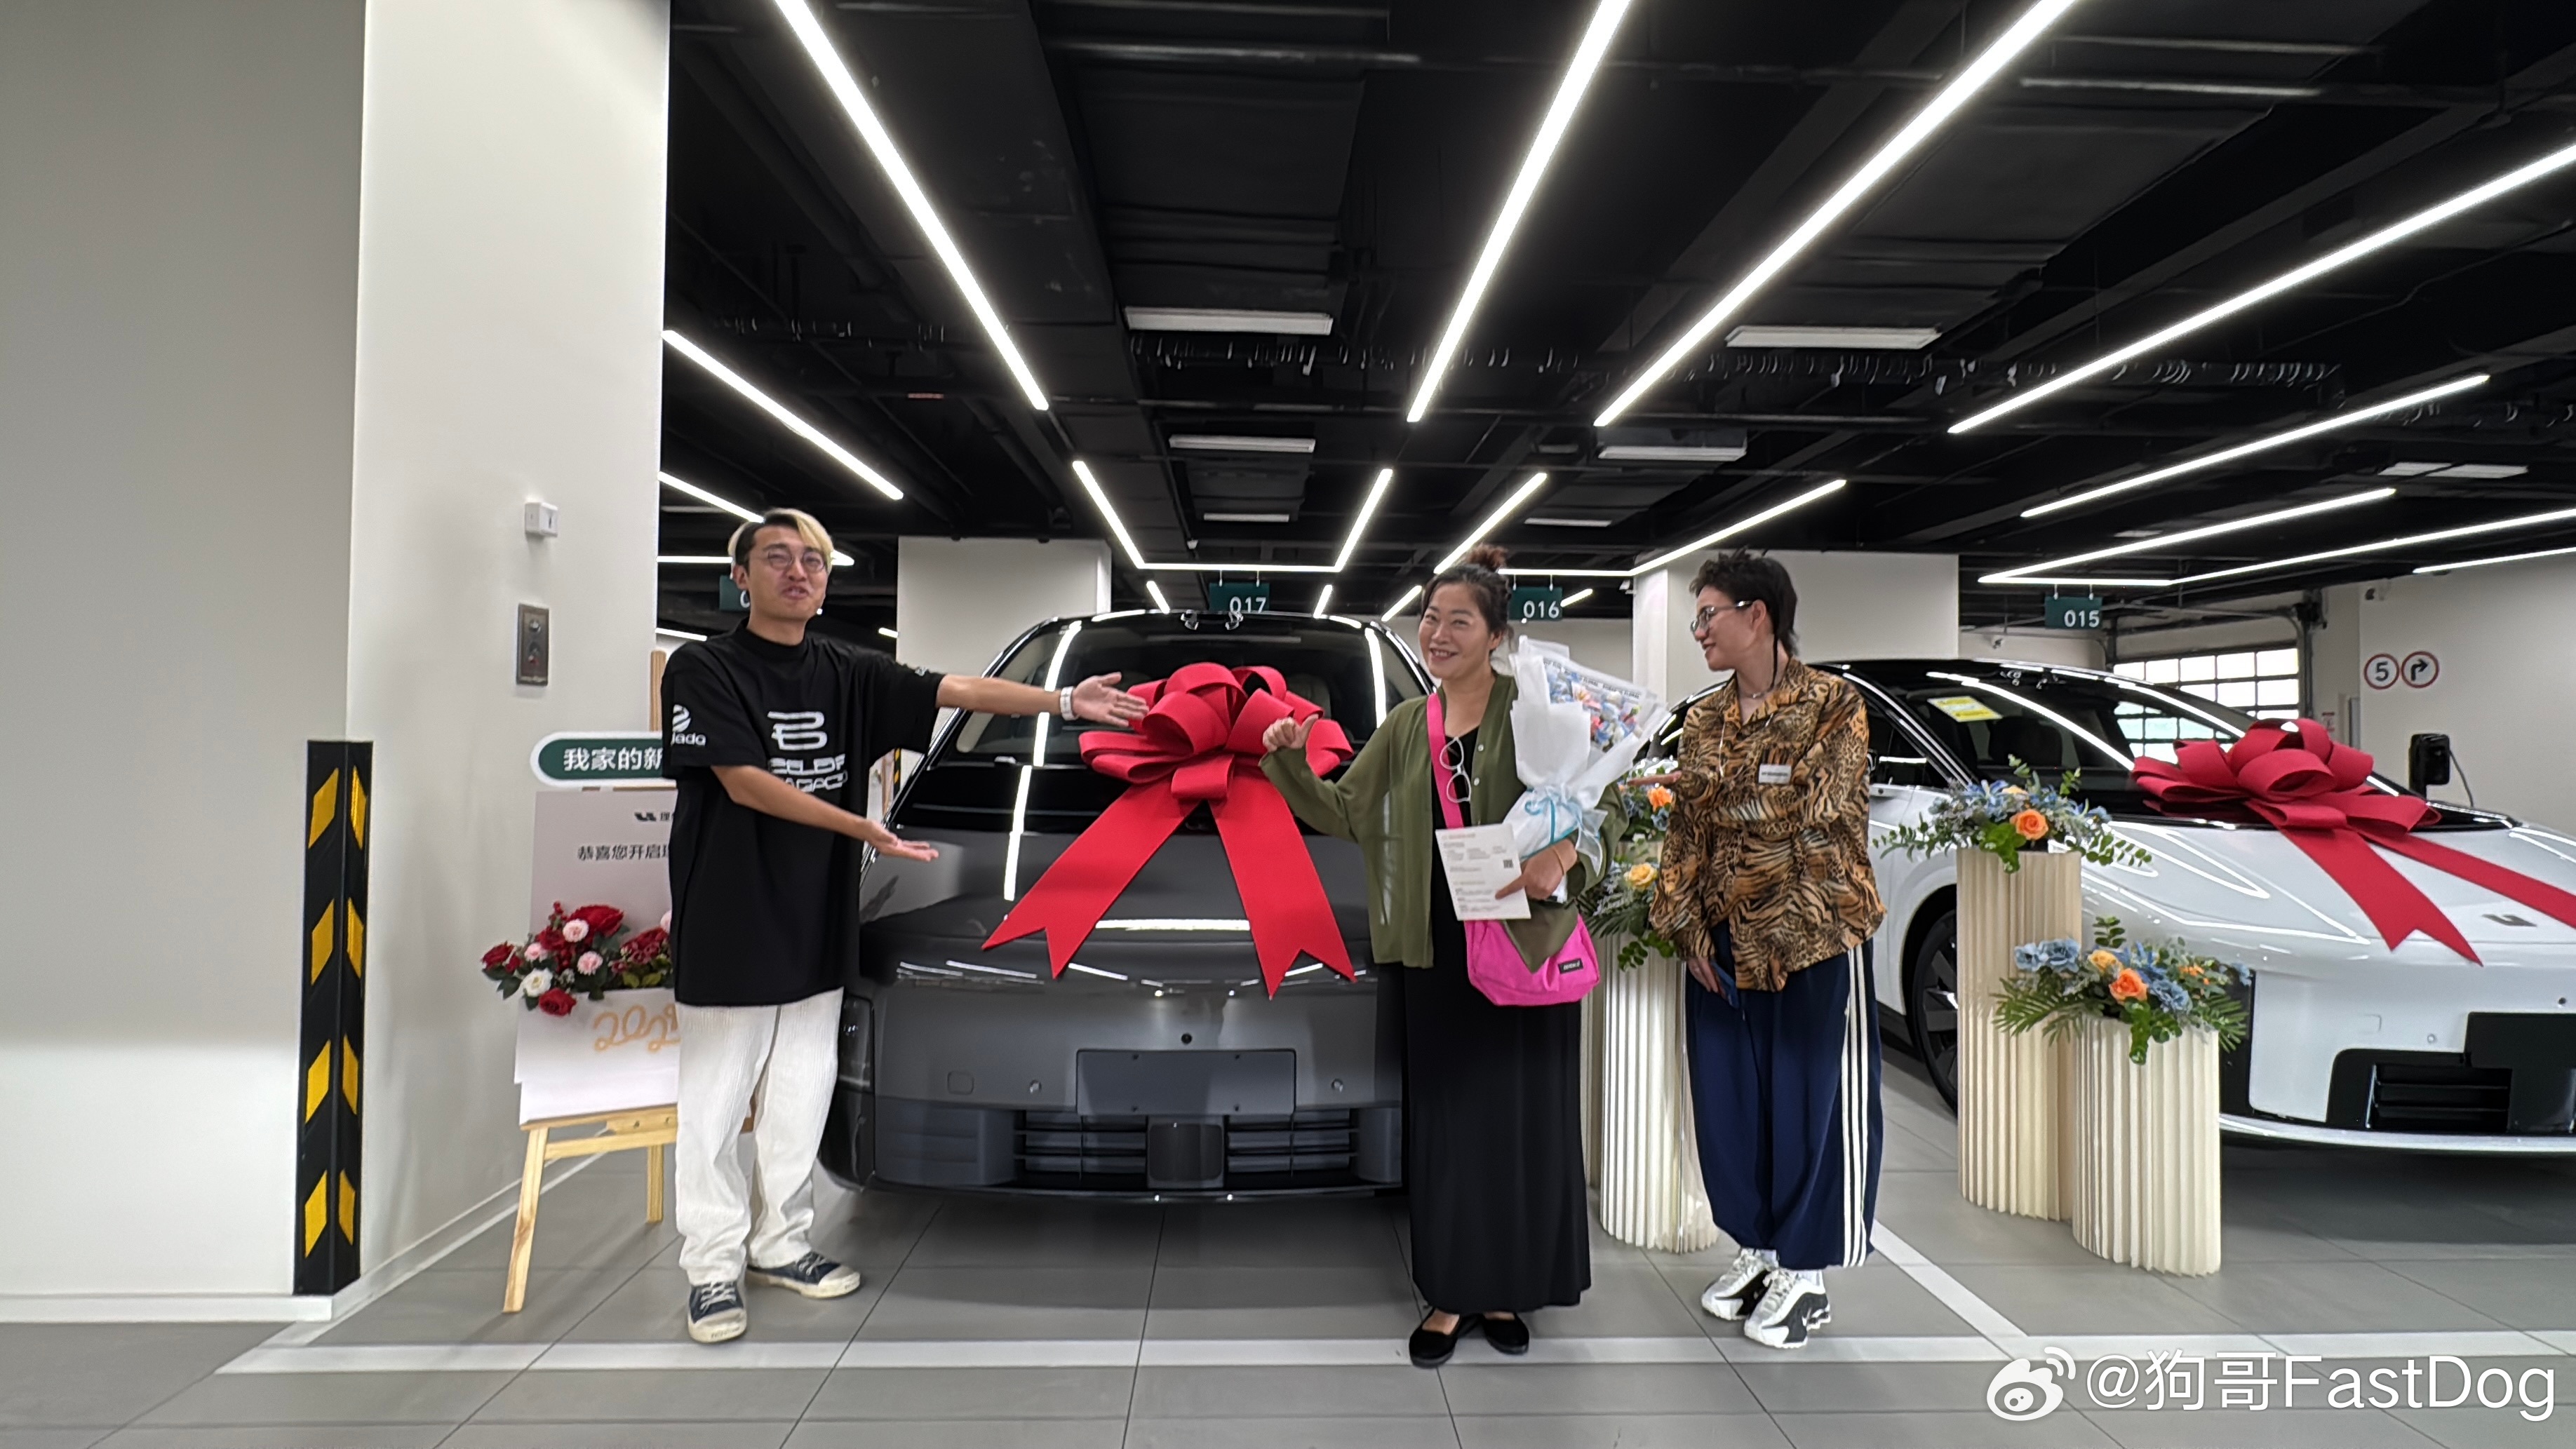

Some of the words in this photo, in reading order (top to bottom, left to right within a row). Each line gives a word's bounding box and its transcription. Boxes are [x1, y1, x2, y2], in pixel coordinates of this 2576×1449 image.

[1230, 596, 1266, 614] 017
[1523, 600, 1559, 619] 016
[2064, 609, 2100, 628] 015
[2375, 661, 2389, 682] 5
[563, 747, 663, 771] 我家的新
